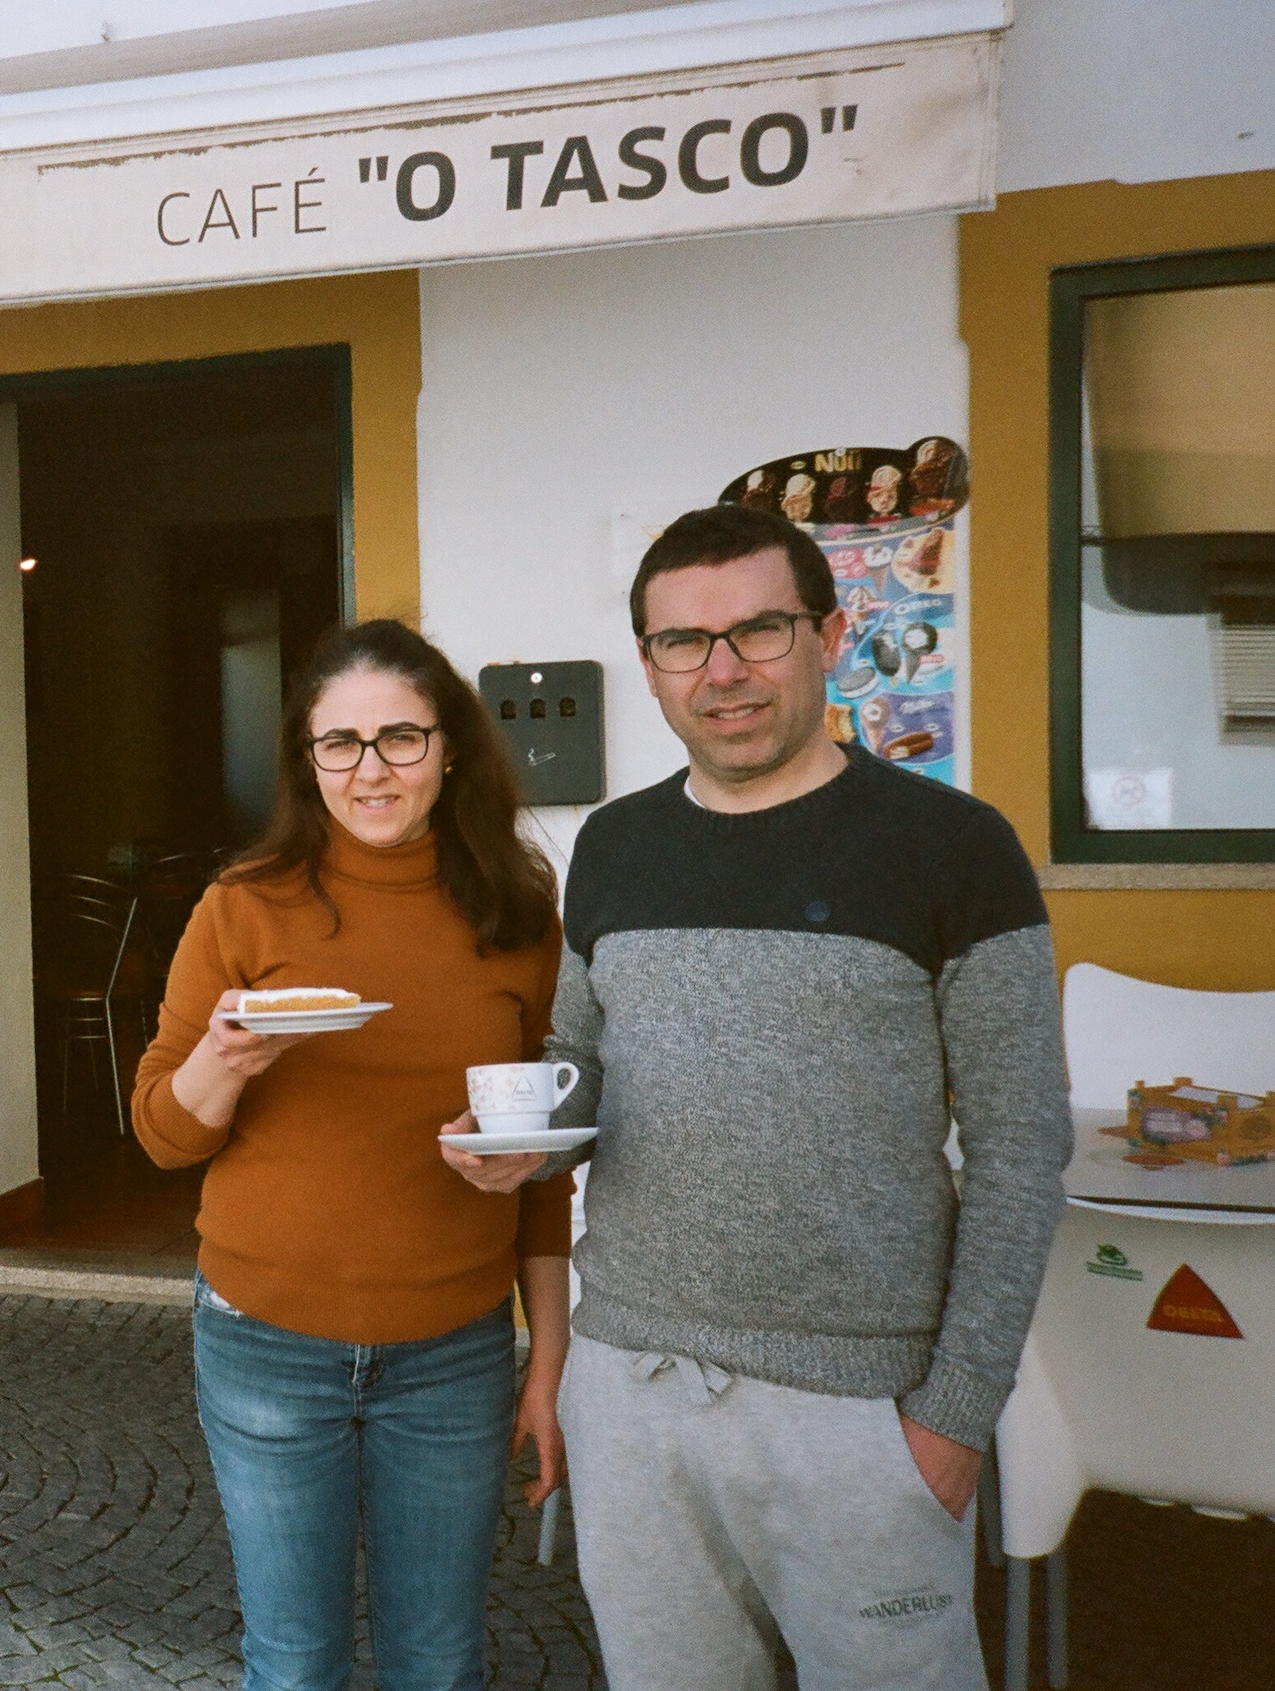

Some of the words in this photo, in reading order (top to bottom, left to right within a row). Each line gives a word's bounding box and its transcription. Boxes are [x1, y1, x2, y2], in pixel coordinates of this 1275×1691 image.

[156, 166, 328, 247] CAFÉ
[358, 149, 456, 222] "O
[490, 103, 859, 212] TASCO"
